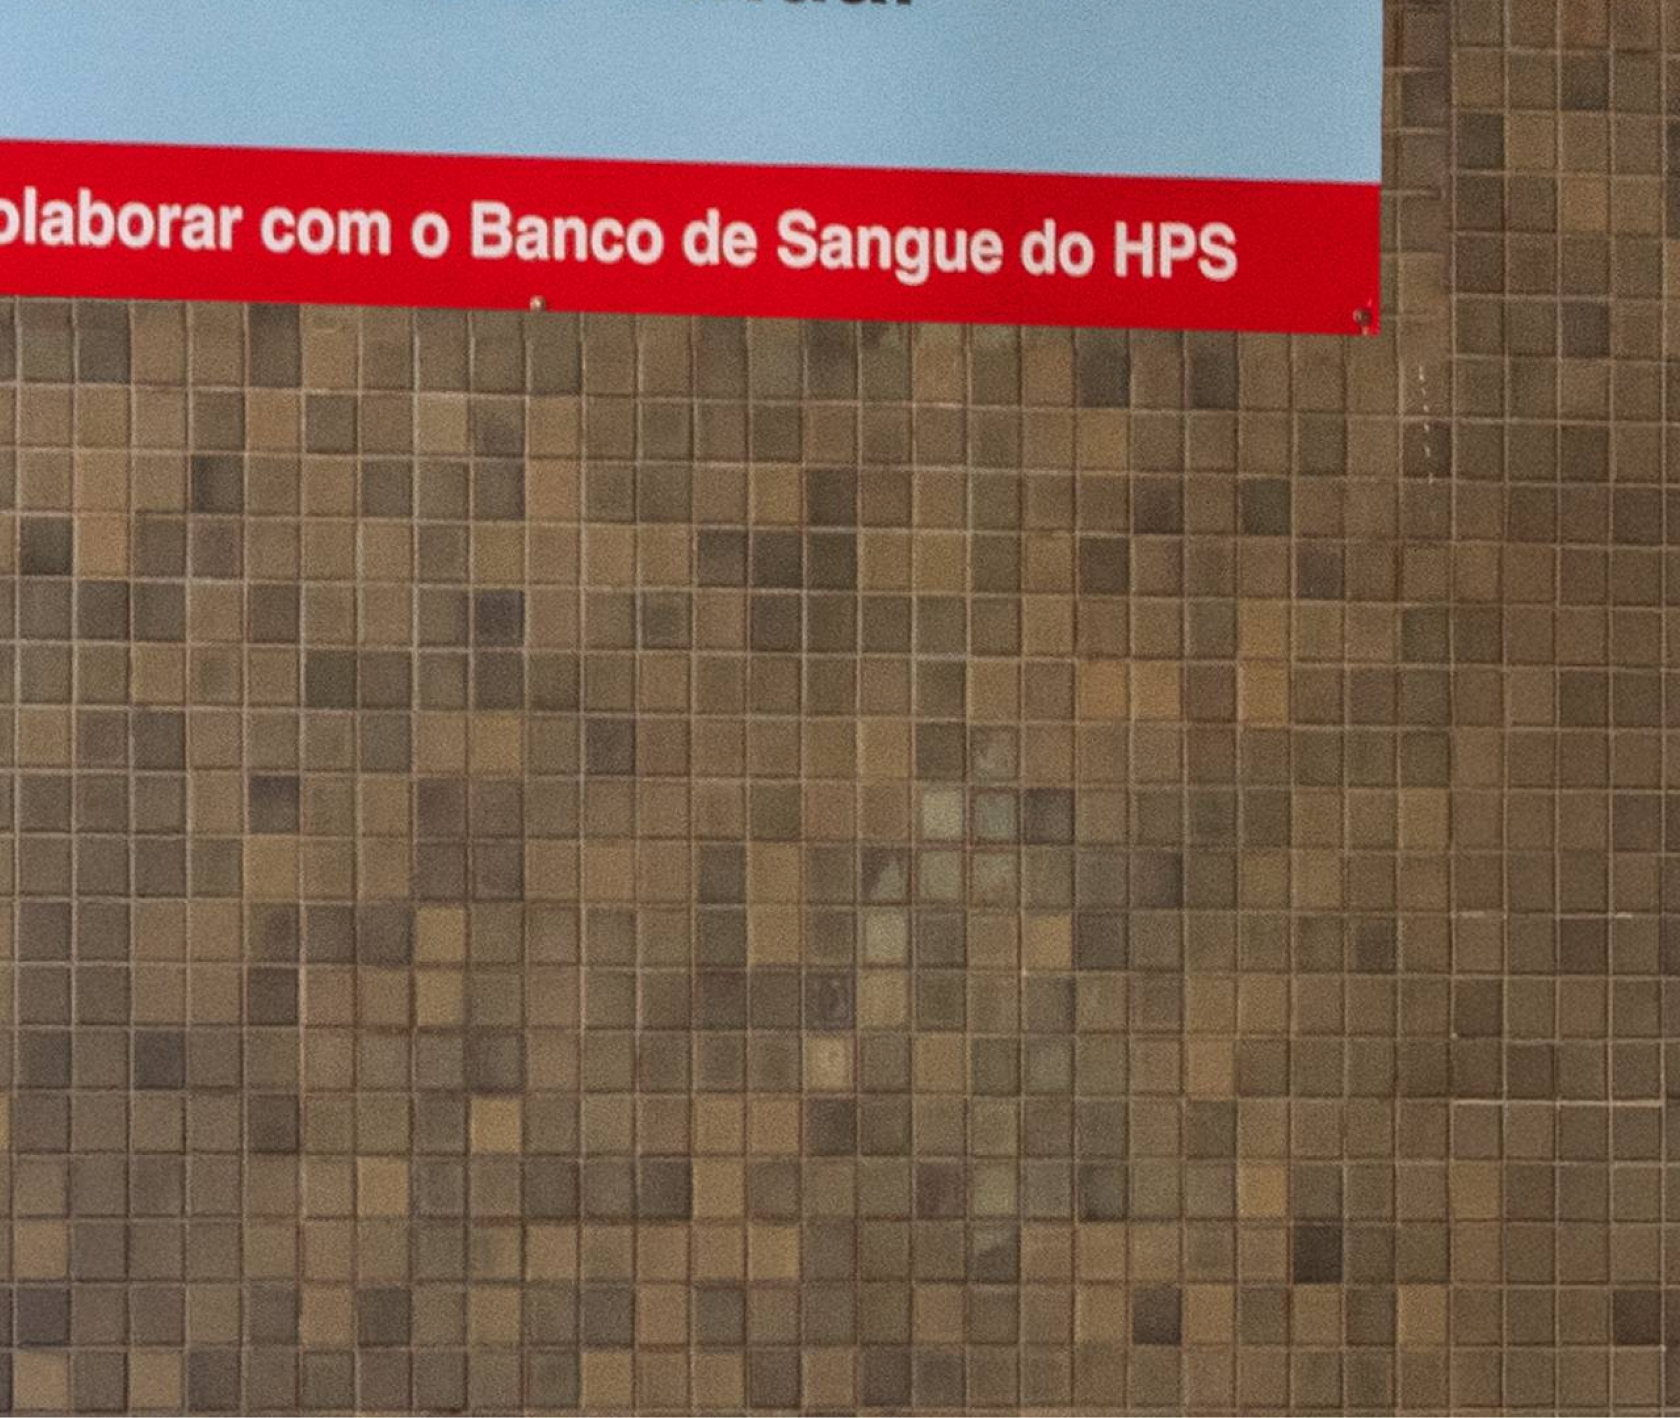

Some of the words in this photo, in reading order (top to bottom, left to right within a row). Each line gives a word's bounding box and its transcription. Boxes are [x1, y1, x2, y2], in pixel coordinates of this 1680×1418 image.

[260, 206, 392, 256] com
[411, 212, 450, 259] o
[471, 200, 665, 265] Banco
[682, 207, 757, 267] de
[776, 208, 1004, 287] Sangue
[1020, 218, 1095, 277] do
[1114, 220, 1238, 282] HPS
